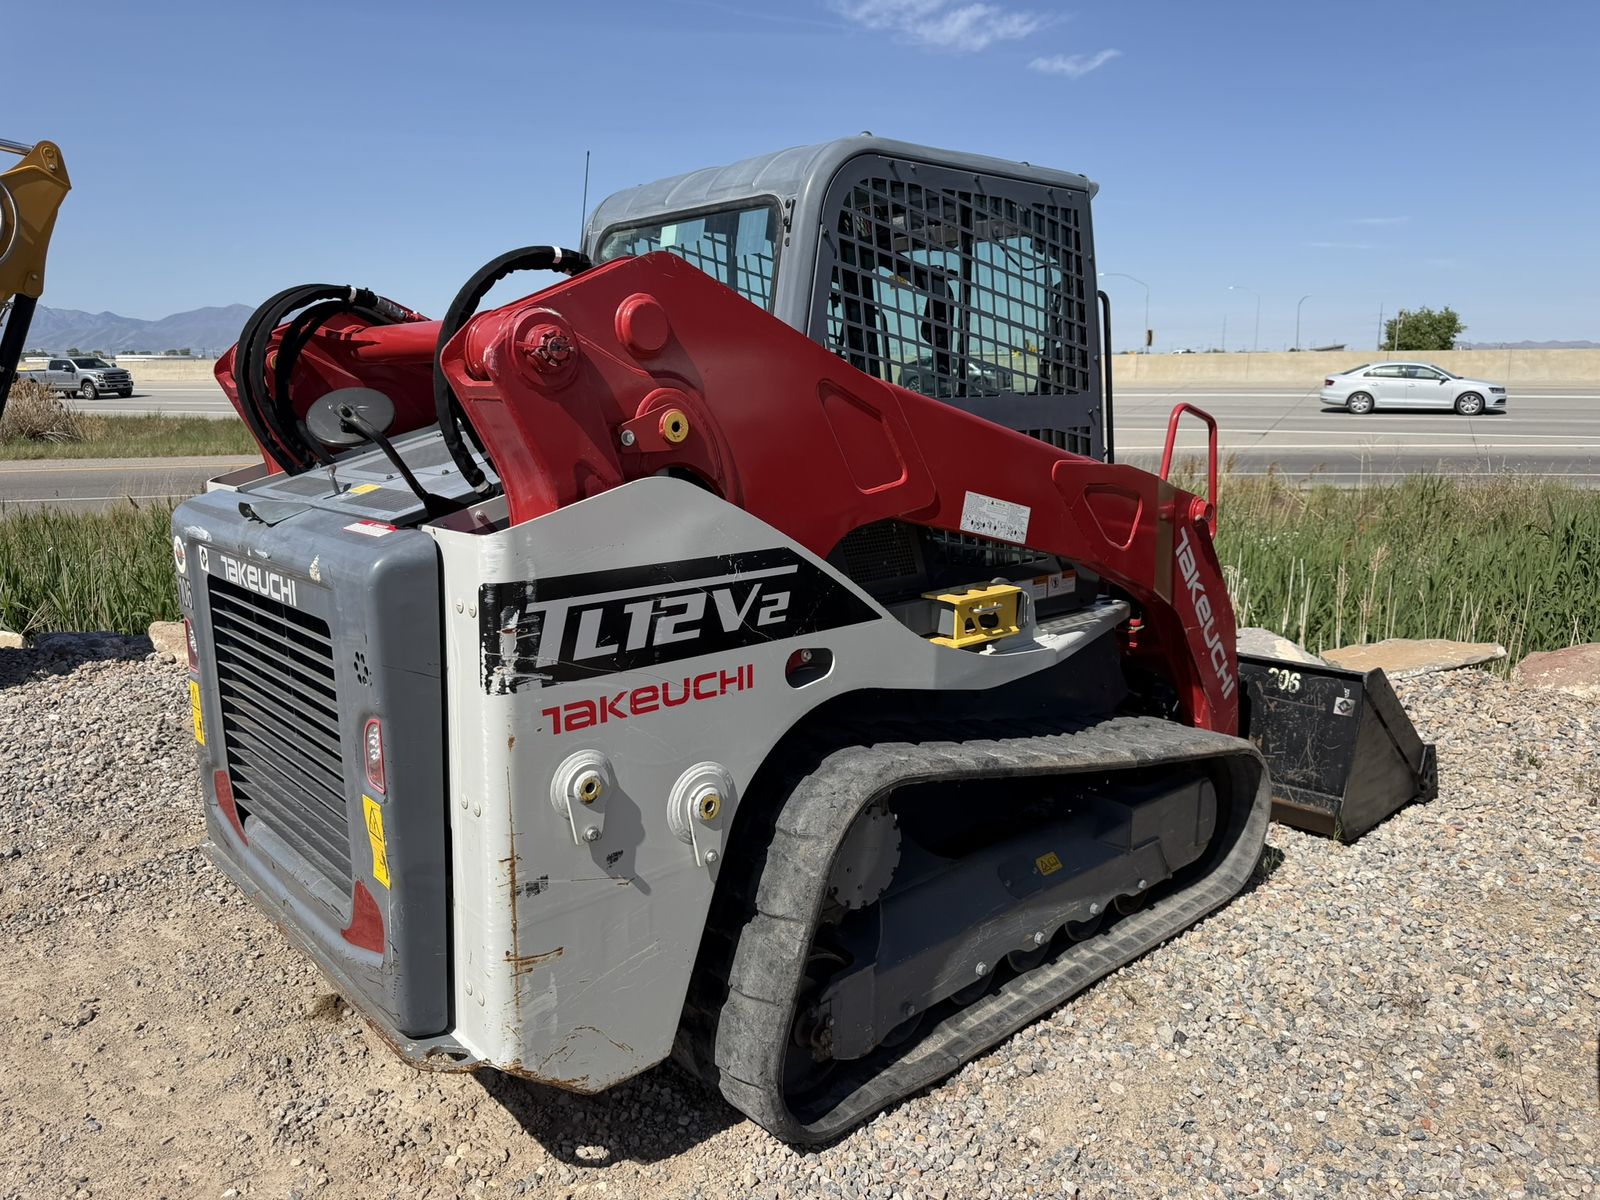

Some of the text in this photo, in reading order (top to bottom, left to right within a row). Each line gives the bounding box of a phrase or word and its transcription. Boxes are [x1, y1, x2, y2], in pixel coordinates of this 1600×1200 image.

[220, 555, 297, 607] TAKEUCHI
[1174, 526, 1236, 700] TAKEUCHI
[541, 663, 755, 736] TAKEUCHI
